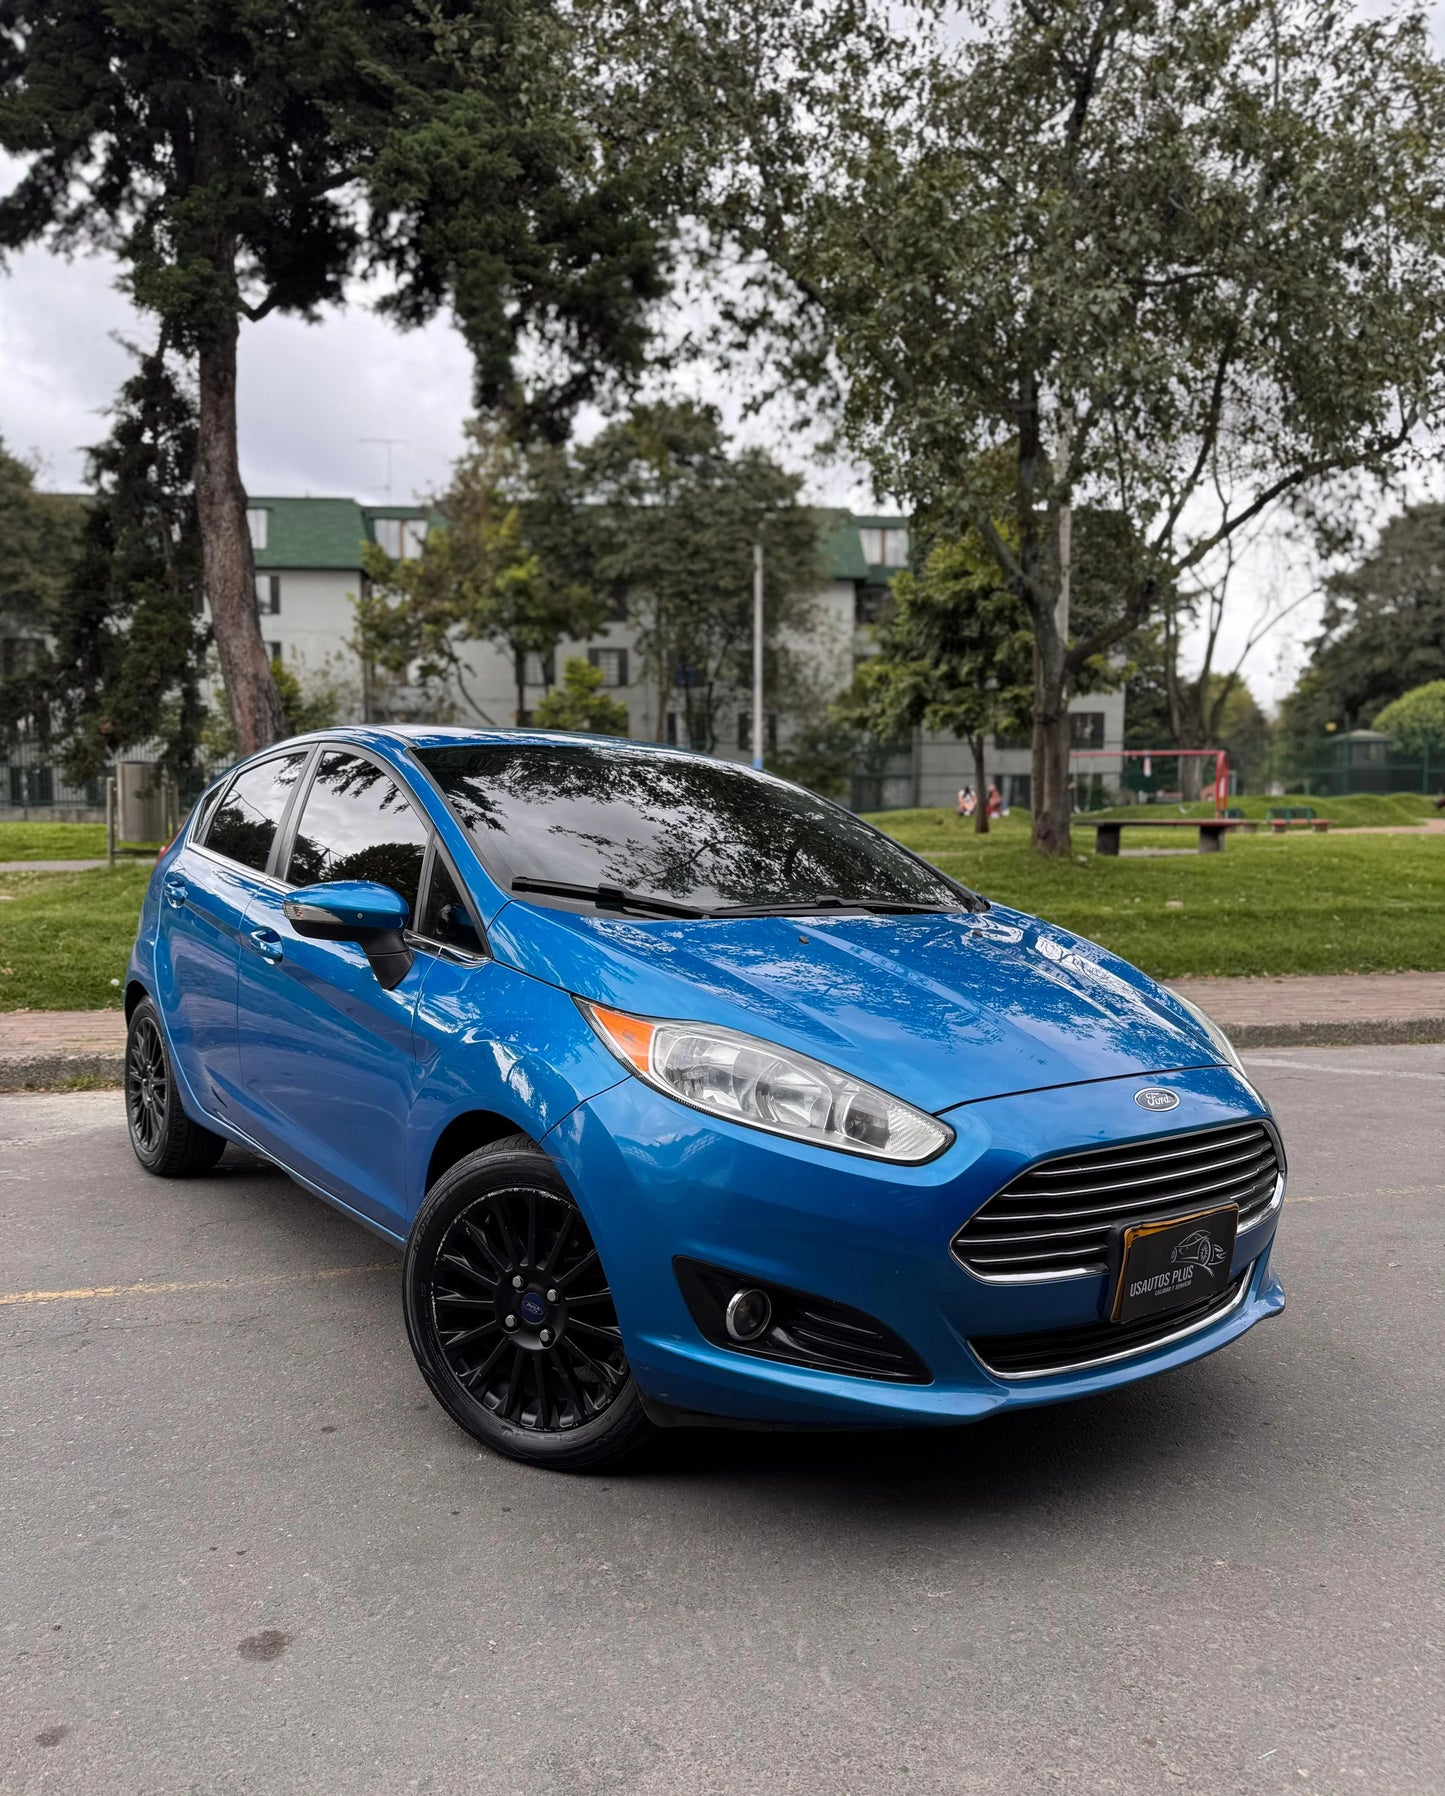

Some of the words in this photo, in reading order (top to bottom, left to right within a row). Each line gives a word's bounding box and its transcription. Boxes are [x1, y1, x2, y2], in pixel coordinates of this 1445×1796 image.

[1145, 1092, 1171, 1106] Ford
[1130, 1272, 1171, 1297] USAUTOS
[1172, 1265, 1194, 1284] PLUS
